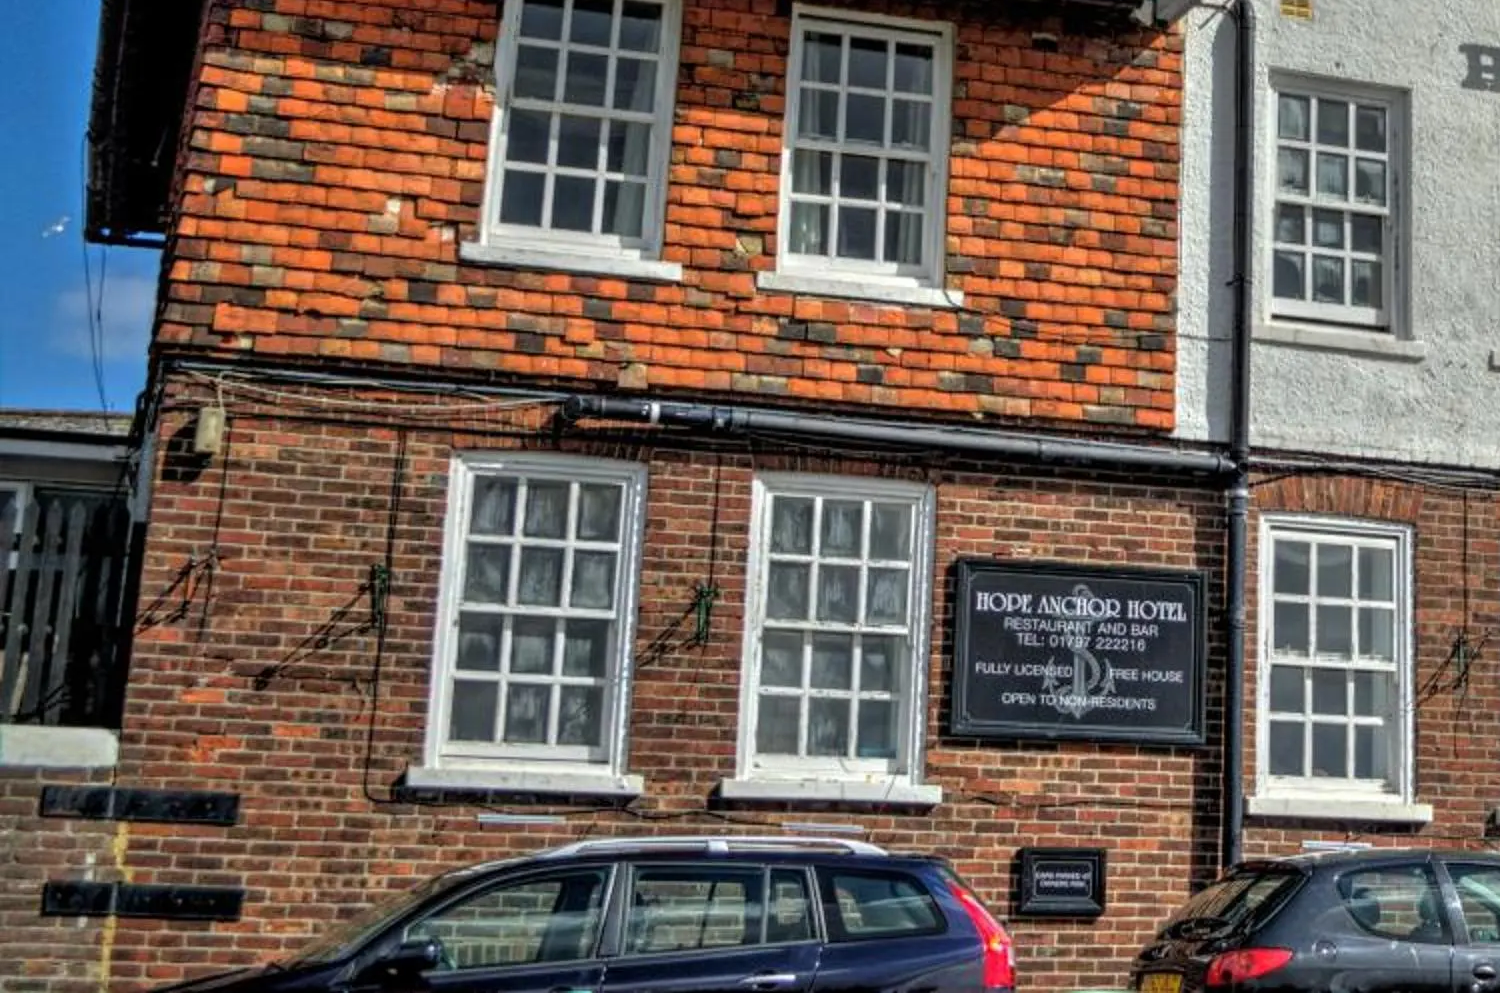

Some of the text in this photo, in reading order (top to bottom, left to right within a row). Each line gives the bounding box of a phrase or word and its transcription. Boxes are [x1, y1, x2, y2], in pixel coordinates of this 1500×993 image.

[976, 591, 1187, 622] HOPE ANCHOR HOTEL
[1003, 617, 1159, 638] RESTAURANT AND BAR
[1016, 632, 1147, 652] TEL: 01797 222216
[975, 662, 1073, 678] FULLY LICENSED
[1109, 668, 1185, 683] FREE HOUSE
[1001, 692, 1157, 711] OPEN TO NON-RESIDENTS
